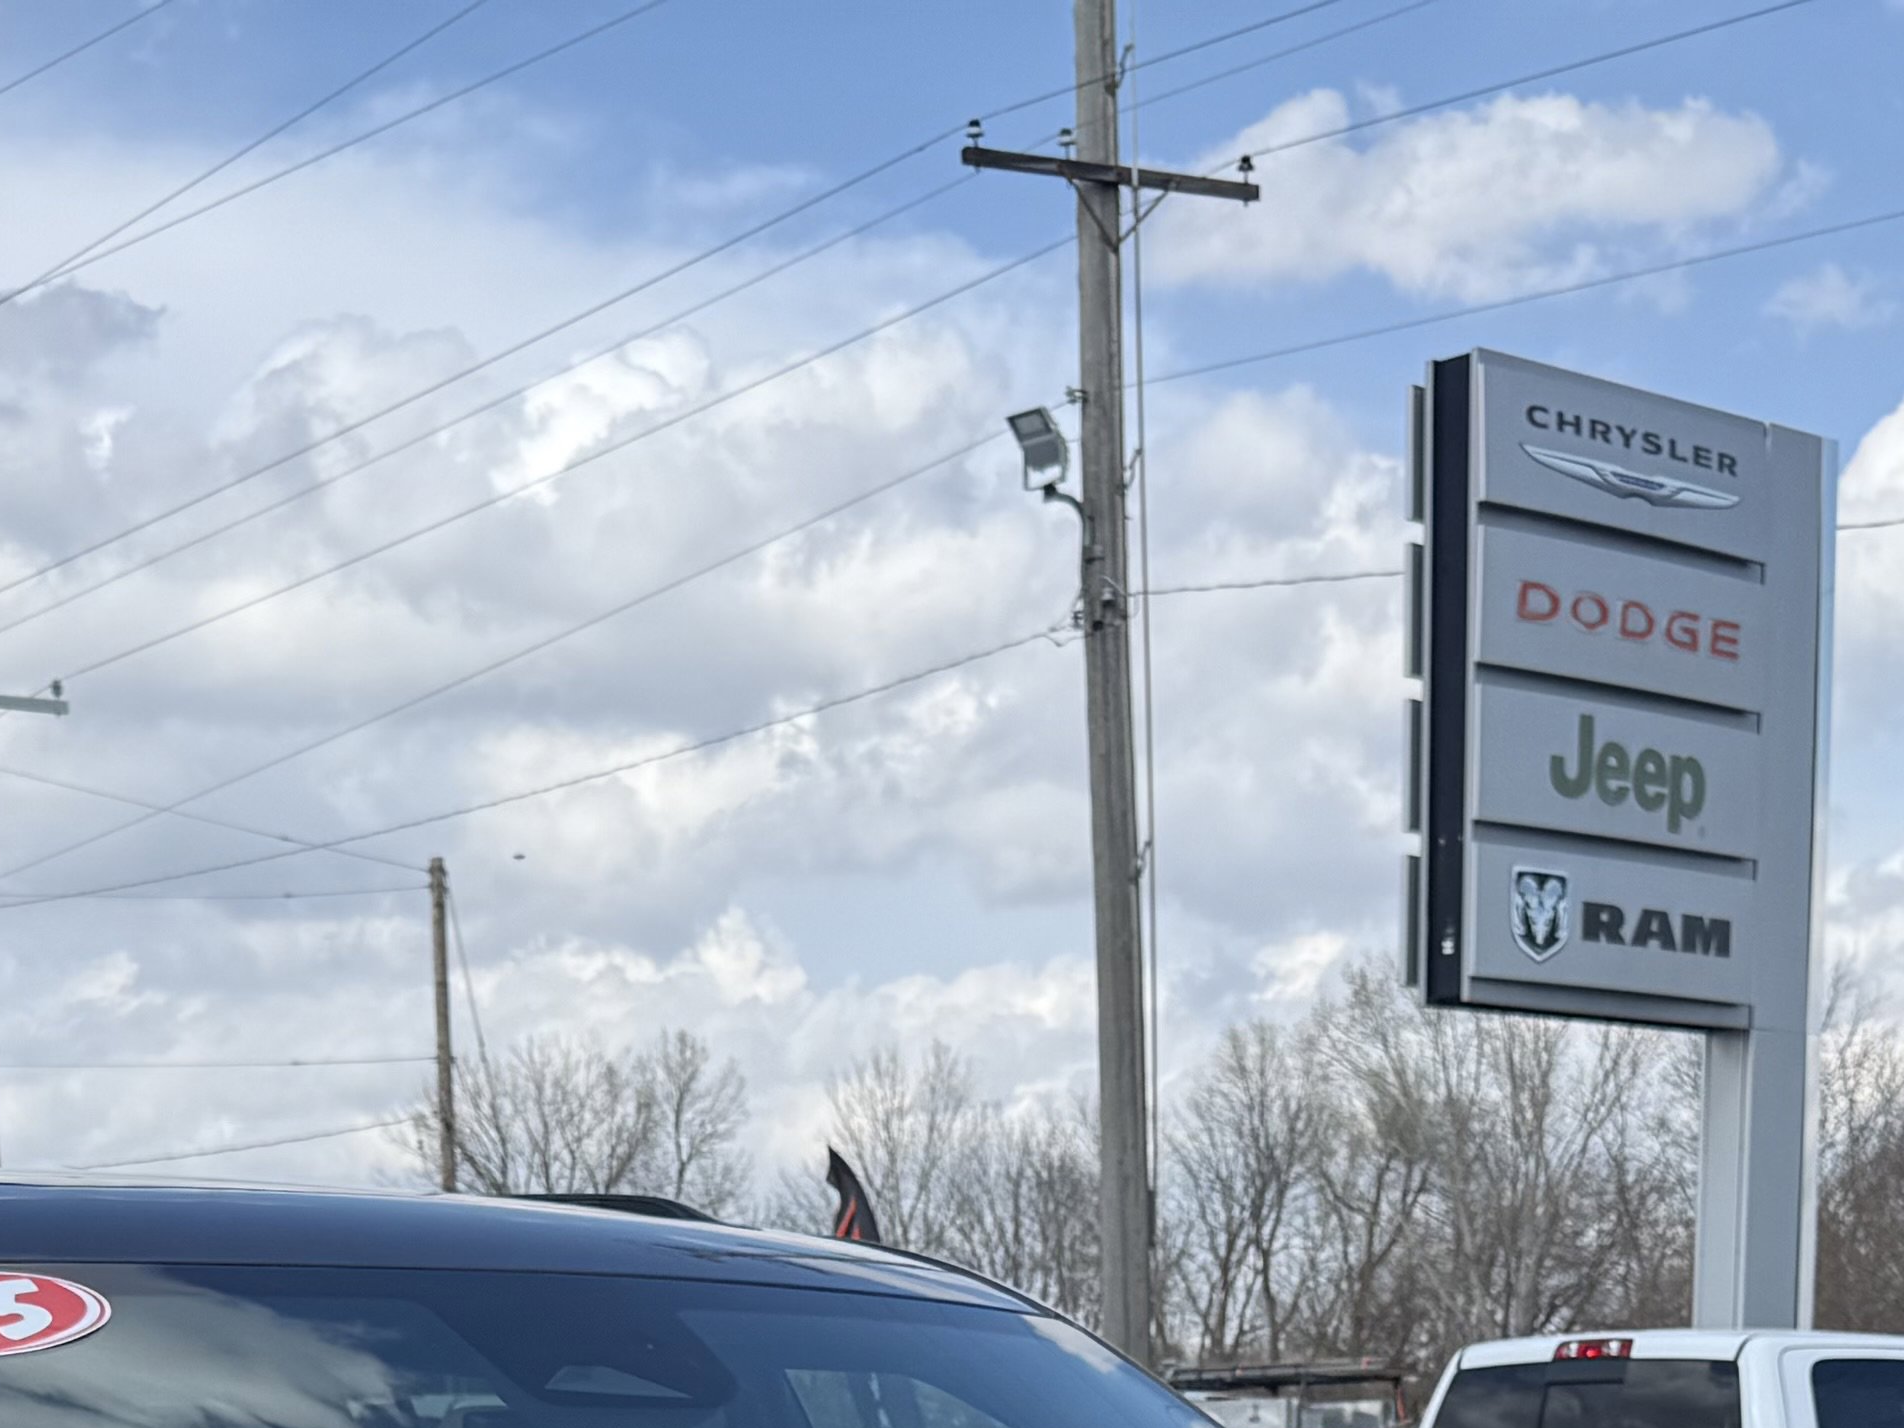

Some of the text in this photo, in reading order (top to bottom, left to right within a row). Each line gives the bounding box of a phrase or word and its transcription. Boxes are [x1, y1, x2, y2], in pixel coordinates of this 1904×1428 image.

[1525, 405, 1739, 477] CHRYSLER
[1516, 580, 1741, 660] DODGE
[1549, 713, 1706, 834] Jeep
[1581, 901, 1732, 958] RAM
